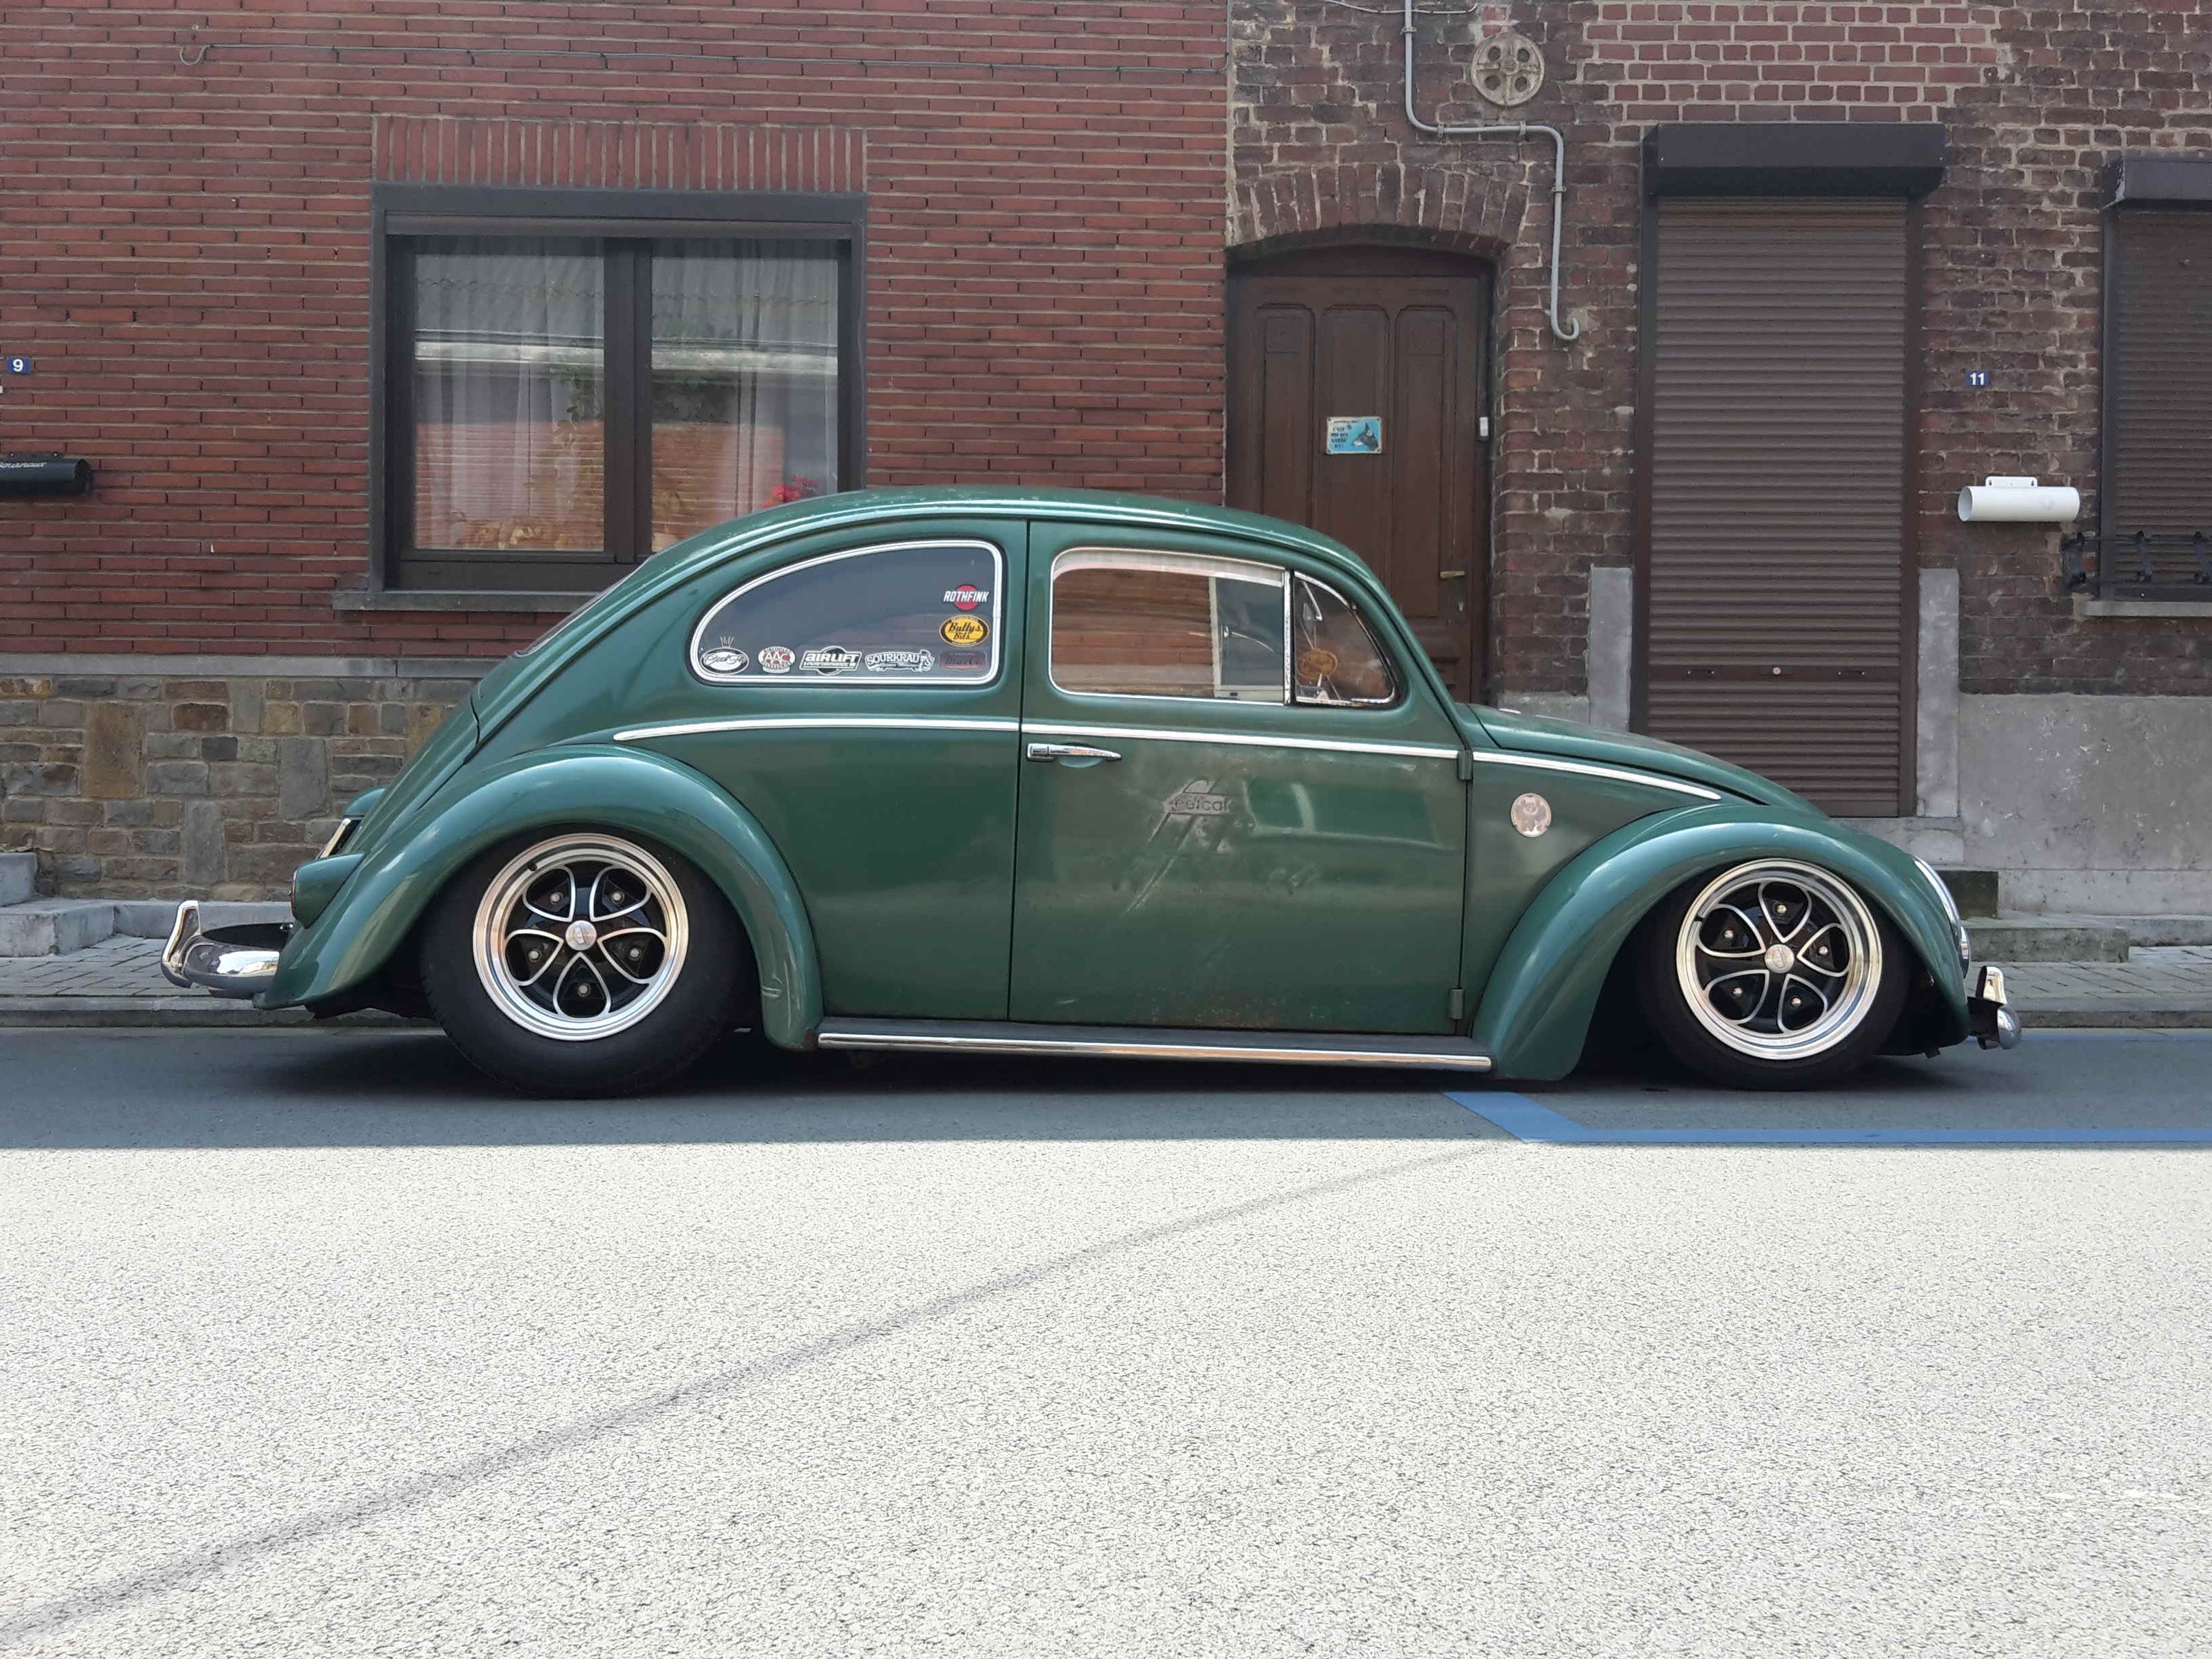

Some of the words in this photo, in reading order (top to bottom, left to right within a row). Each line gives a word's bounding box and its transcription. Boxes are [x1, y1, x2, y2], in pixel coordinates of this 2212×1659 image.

[12, 358, 24, 372] 9
[1969, 372, 1985, 386] 11
[943, 590, 989, 603] ROTHFINK
